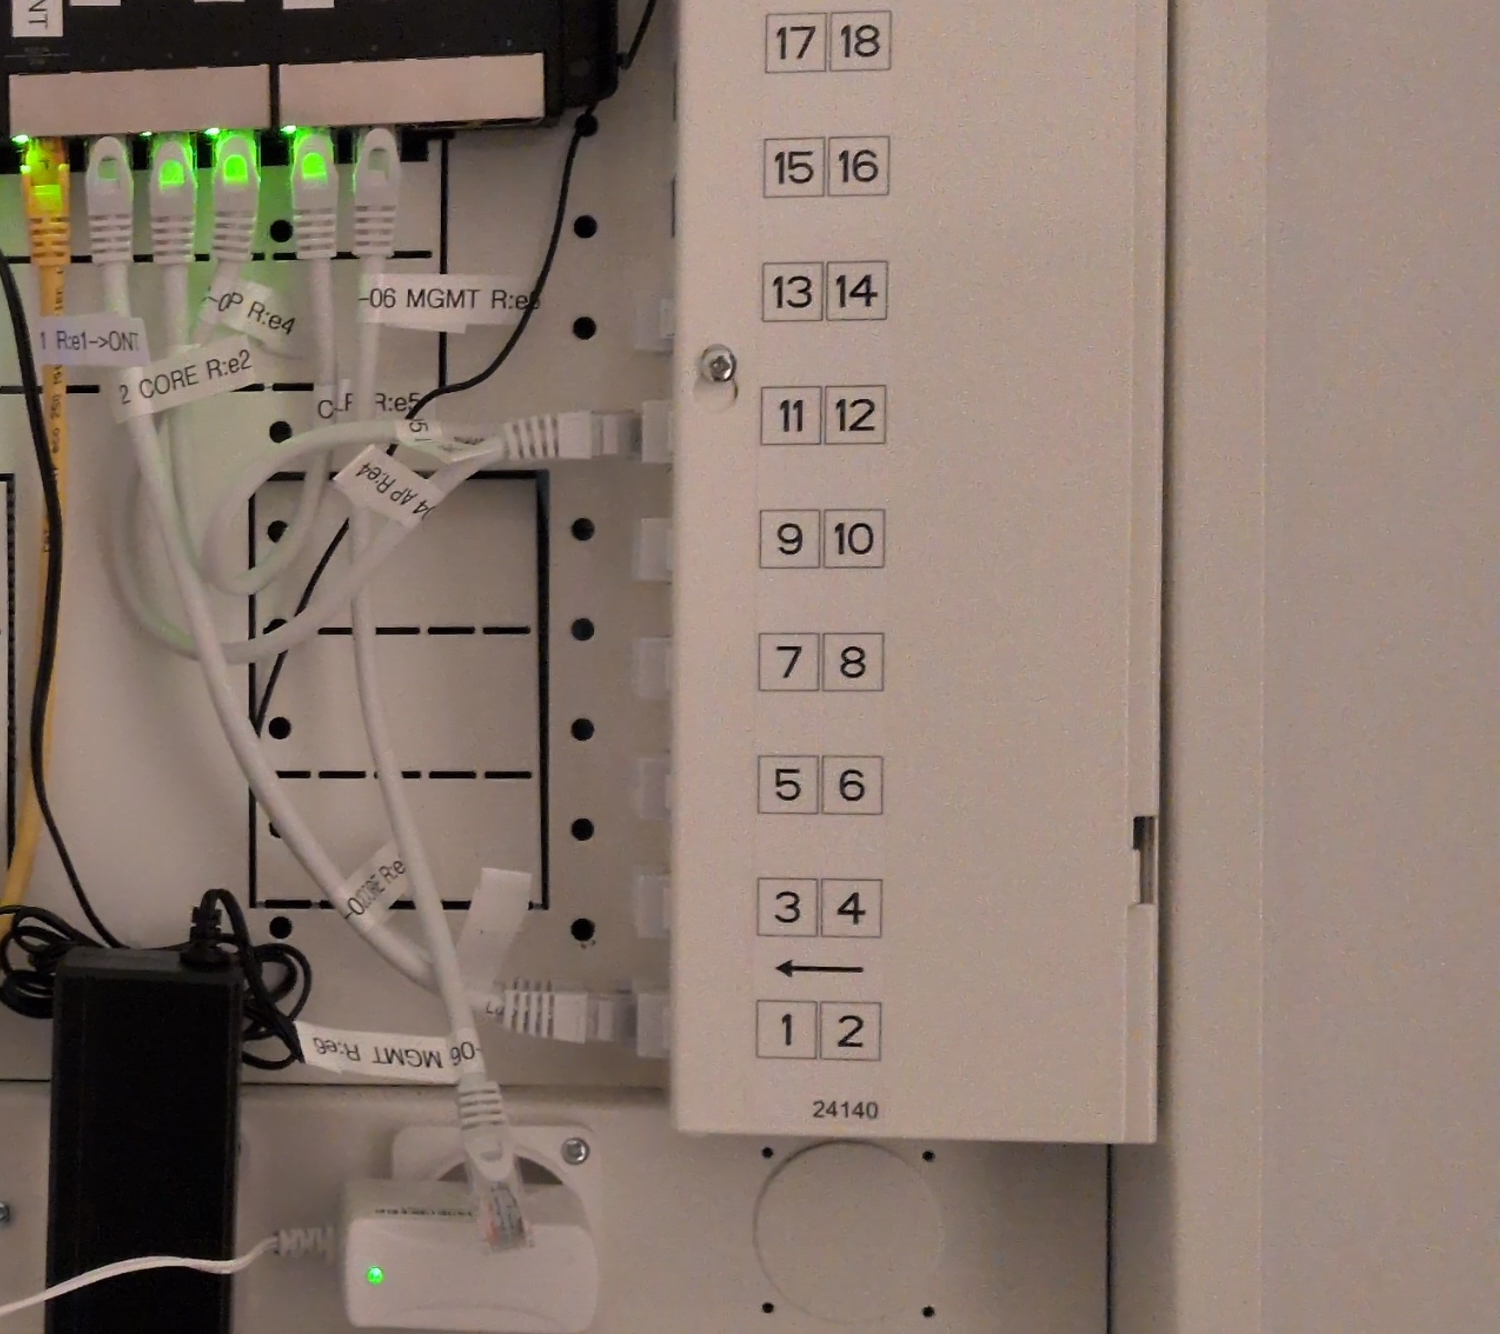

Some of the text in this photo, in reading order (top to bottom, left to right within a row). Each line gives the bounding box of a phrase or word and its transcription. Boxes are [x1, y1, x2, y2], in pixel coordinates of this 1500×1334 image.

[776, 24, 881, 60] 17 18
[774, 149, 879, 185] 15 16
[406, 288, 481, 309] MGMT
[772, 274, 878, 309] 13 14
[247, 300, 296, 335] R:e4
[118, 348, 253, 405] 2 CORE R:e2
[779, 398, 875, 433] 11 12
[777, 522, 874, 556] 9 10
[776, 645, 866, 679] 7 8
[775, 768, 865, 802] 5 6
[774, 890, 866, 925] 3 4
[781, 1013, 864, 1048] 1 2
[312, 1037, 362, 1062] R:e6
[372, 1046, 444, 1069] MGMT
[812, 1099, 879, 1120] 24140
